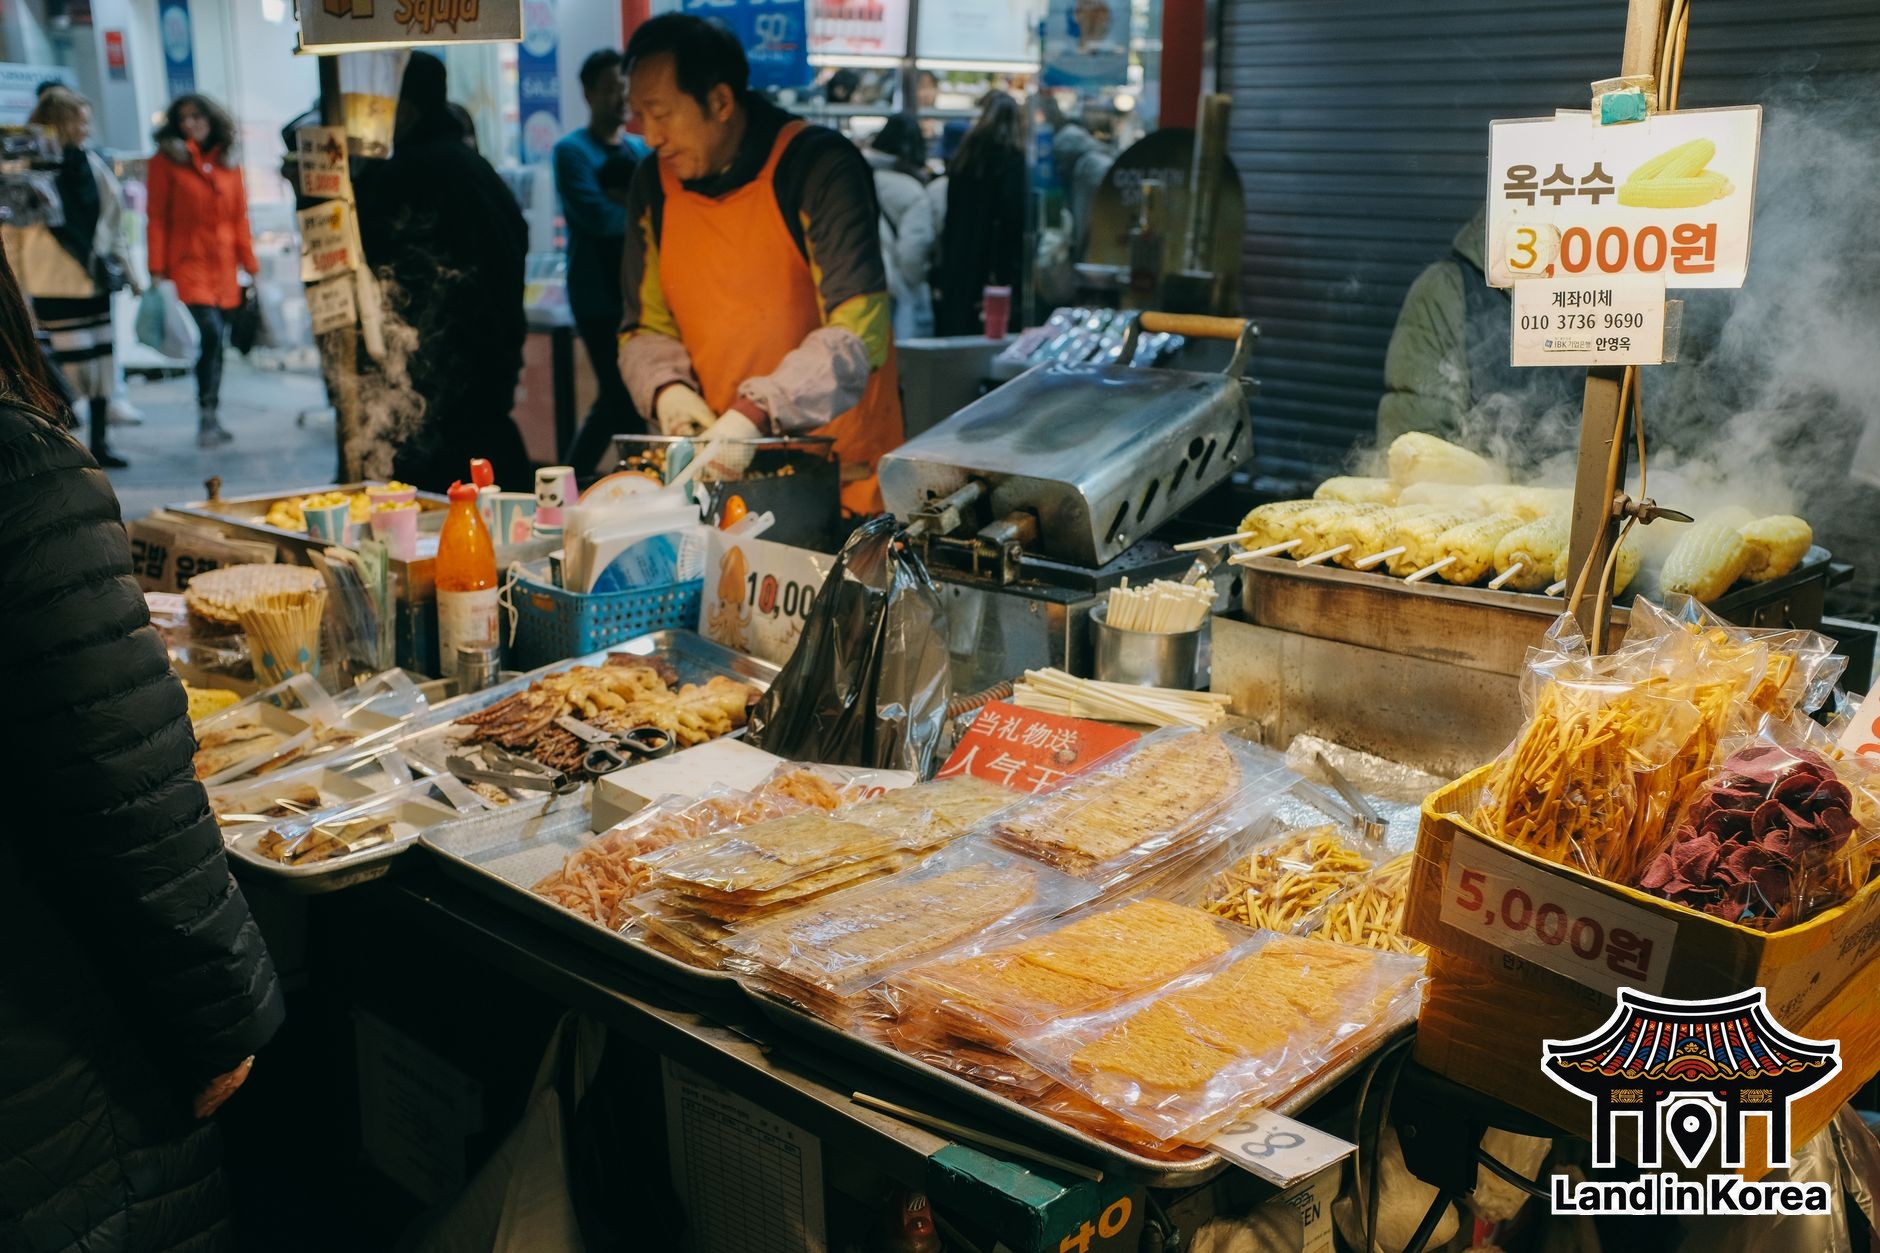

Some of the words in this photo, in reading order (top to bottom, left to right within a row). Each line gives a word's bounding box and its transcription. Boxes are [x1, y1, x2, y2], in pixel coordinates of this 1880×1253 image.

[1504, 162, 1615, 206] 옥수수
[1510, 223, 1717, 279] 3,000원
[1552, 289, 1612, 308] 계좌이체
[1521, 315, 1549, 330] 010
[1557, 314, 1596, 330] 3736
[1604, 312, 1643, 329] 9690
[1595, 336, 1631, 352] 안영옥
[972, 710, 1079, 752] 当礼物送
[1456, 868, 1654, 983] 5,000원
